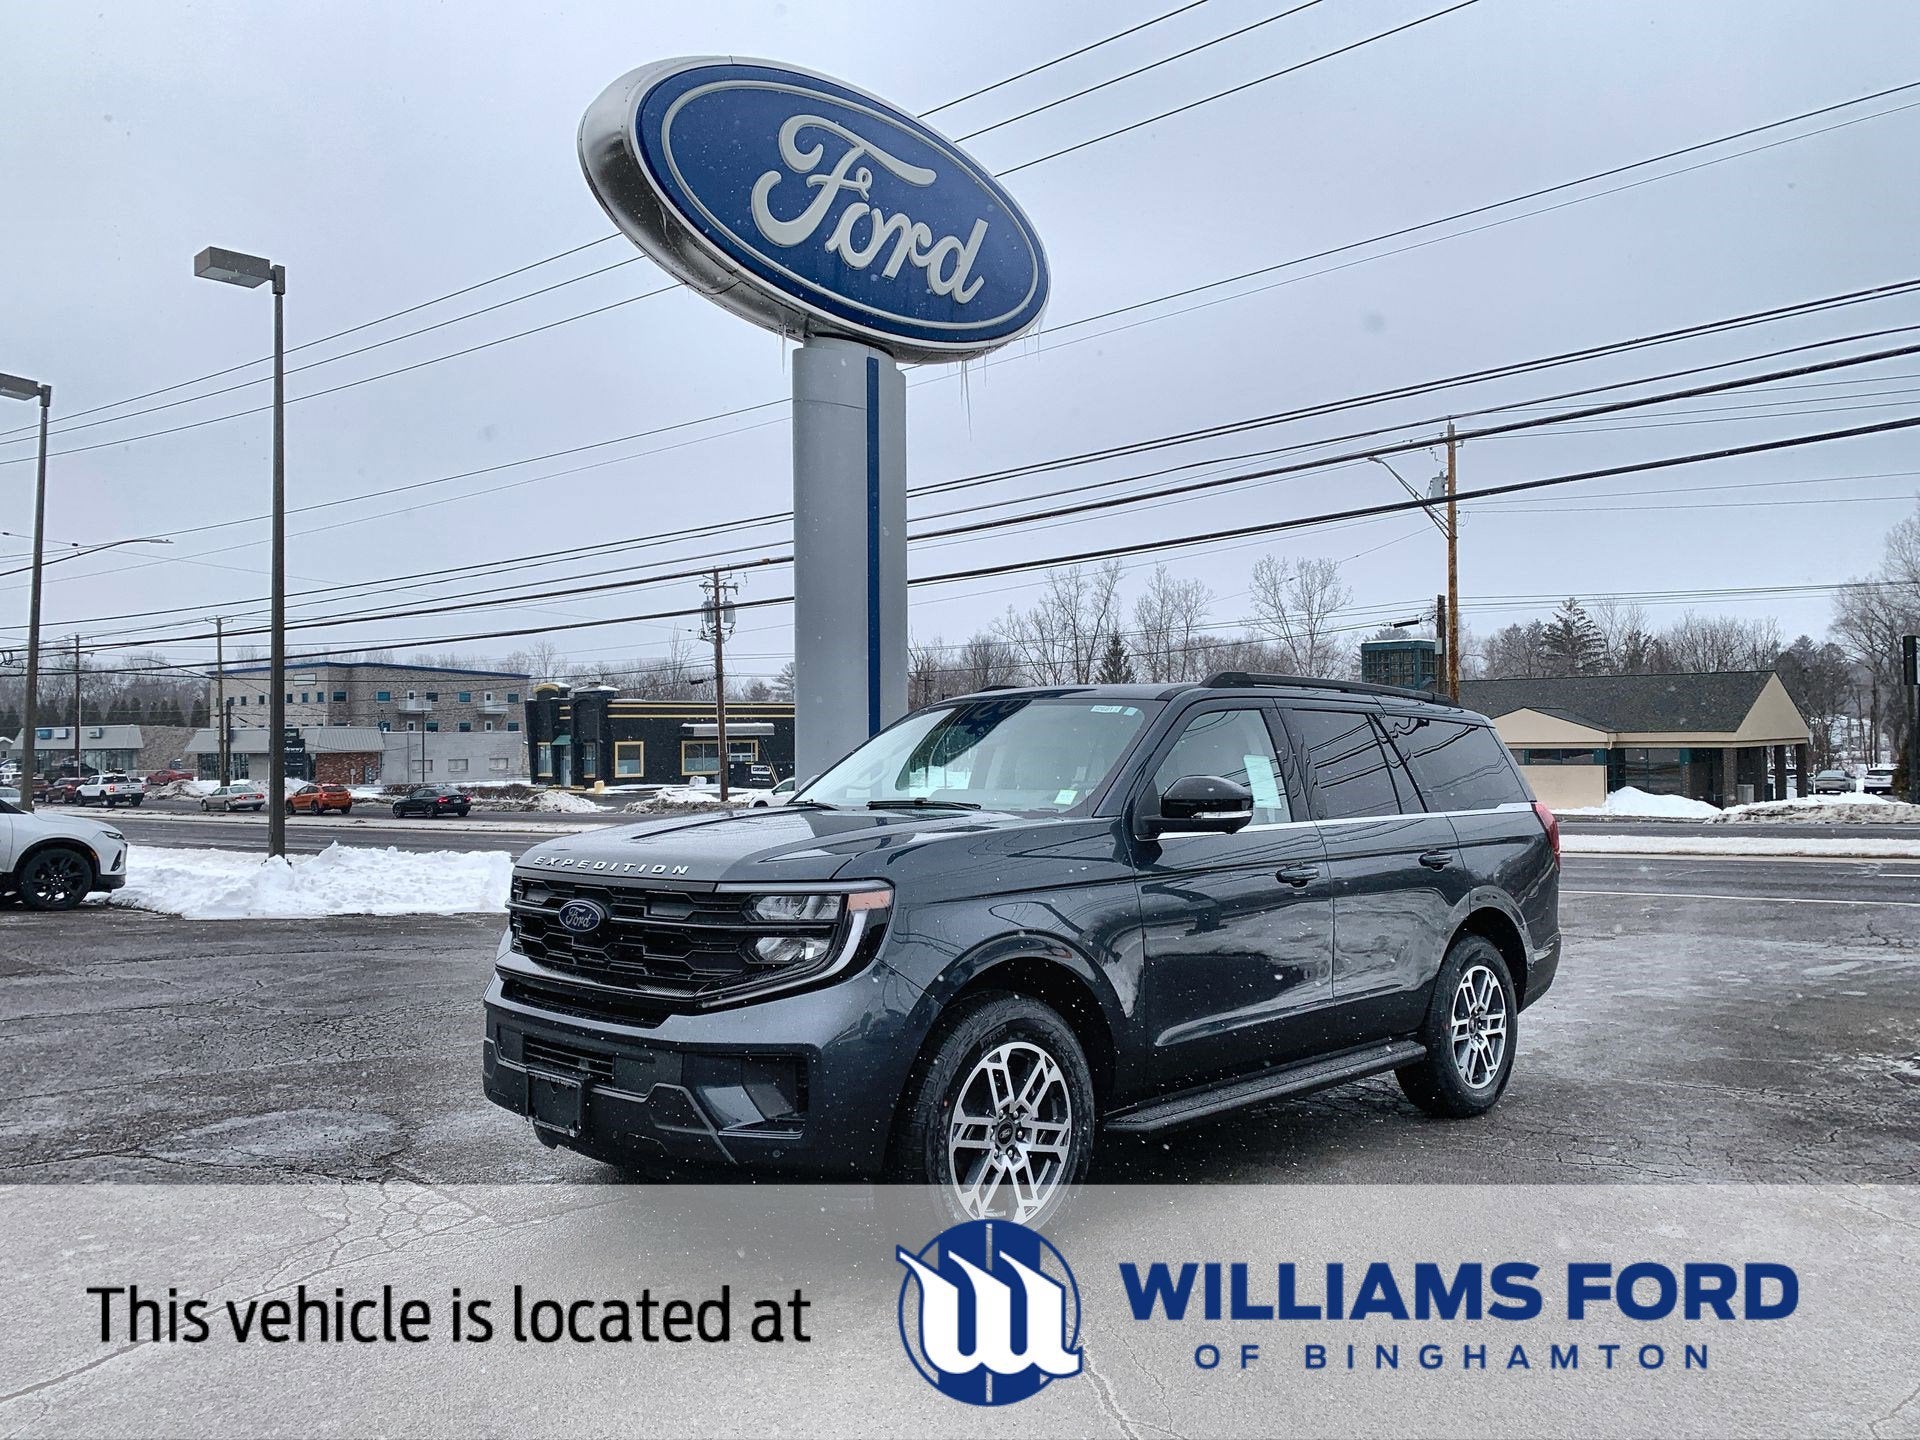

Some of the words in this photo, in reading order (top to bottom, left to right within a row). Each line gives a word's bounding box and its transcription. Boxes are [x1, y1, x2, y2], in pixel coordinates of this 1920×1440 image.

[751, 114, 989, 304] Ford
[534, 856, 689, 875] EXPEDITION
[565, 906, 592, 928] Ford
